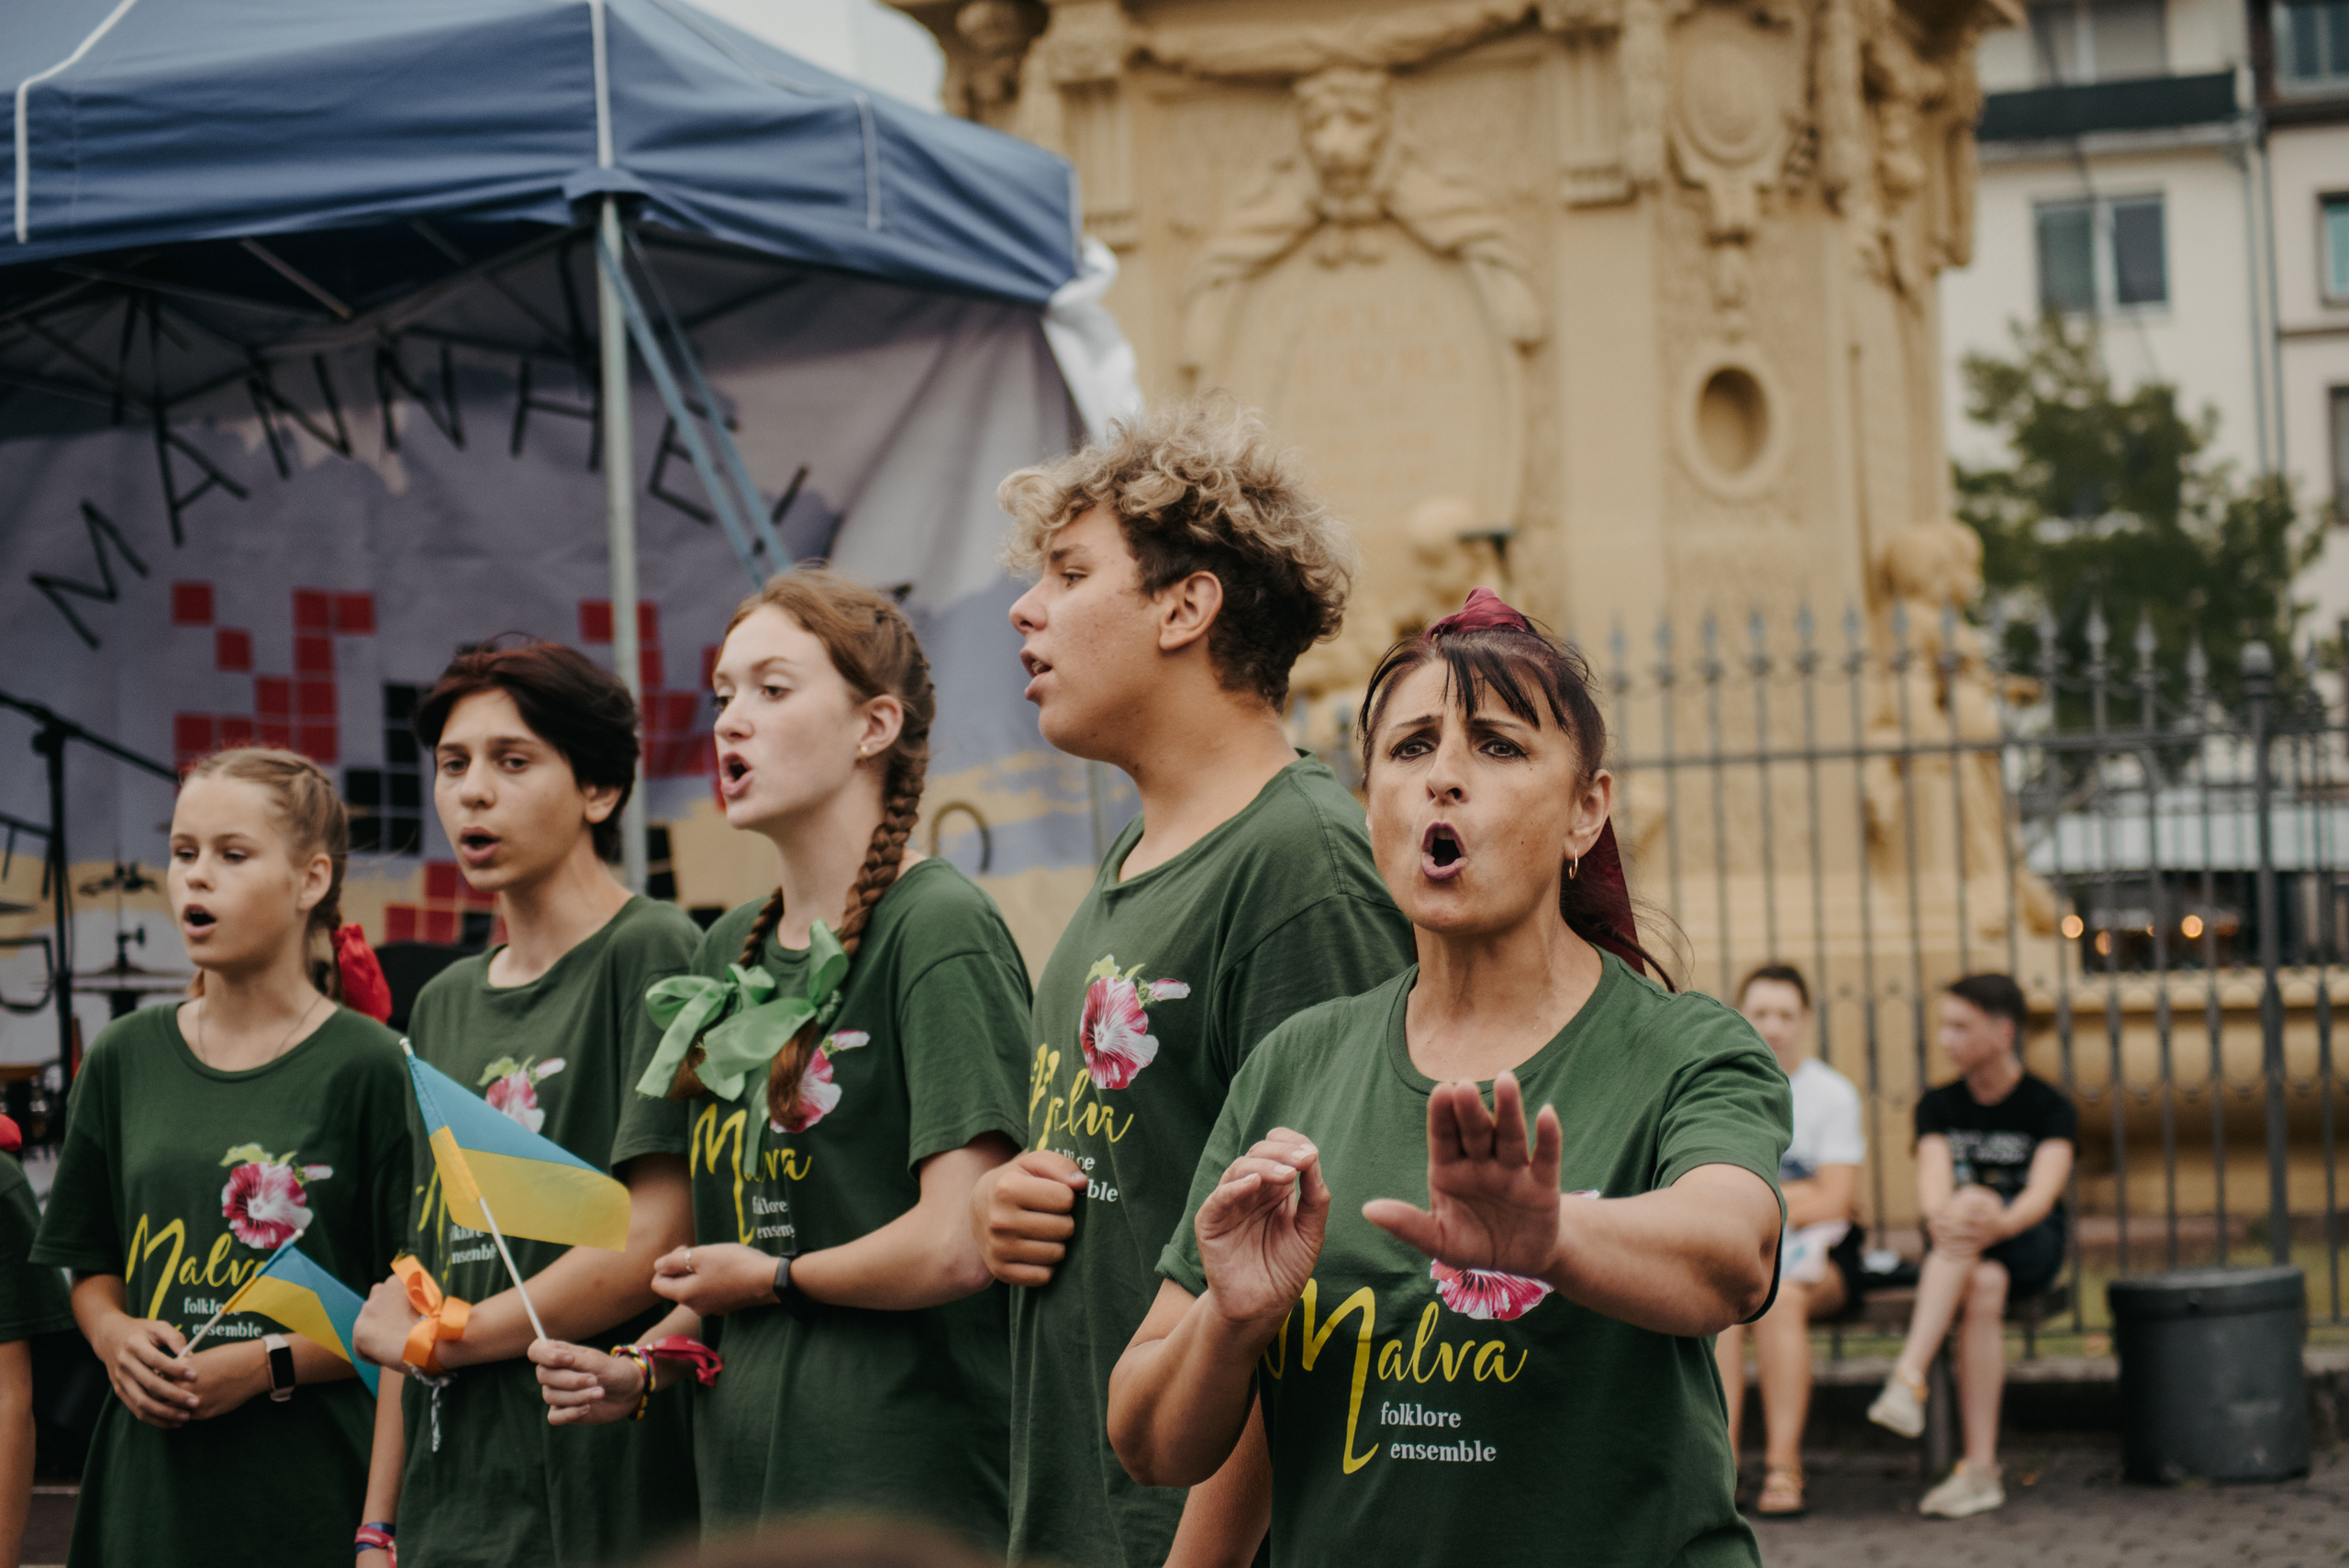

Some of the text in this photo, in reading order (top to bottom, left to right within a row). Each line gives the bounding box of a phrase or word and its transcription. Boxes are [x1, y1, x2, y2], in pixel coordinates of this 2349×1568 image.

[1263, 1277, 1529, 1475] Malva
[1379, 1400, 1462, 1429] folklore
[1389, 1440, 1497, 1462] ensemble
